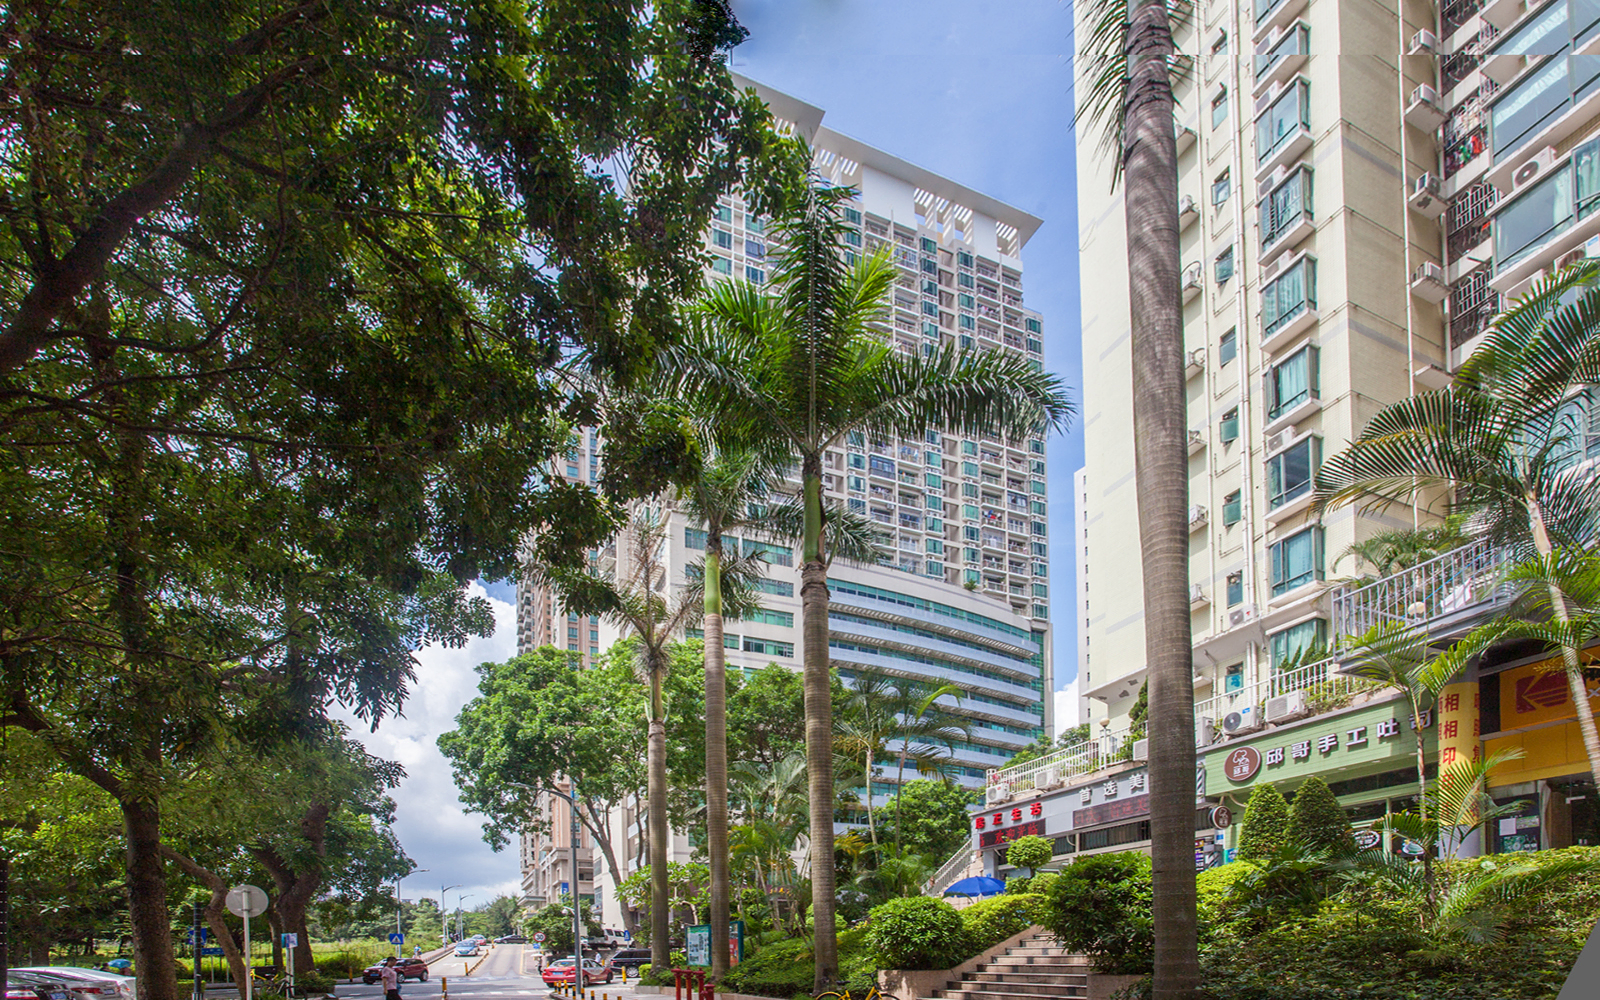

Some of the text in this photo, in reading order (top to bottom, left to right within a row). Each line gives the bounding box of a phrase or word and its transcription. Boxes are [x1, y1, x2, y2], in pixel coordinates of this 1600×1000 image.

[1265, 708, 1432, 767] 邱哥手工吐司
